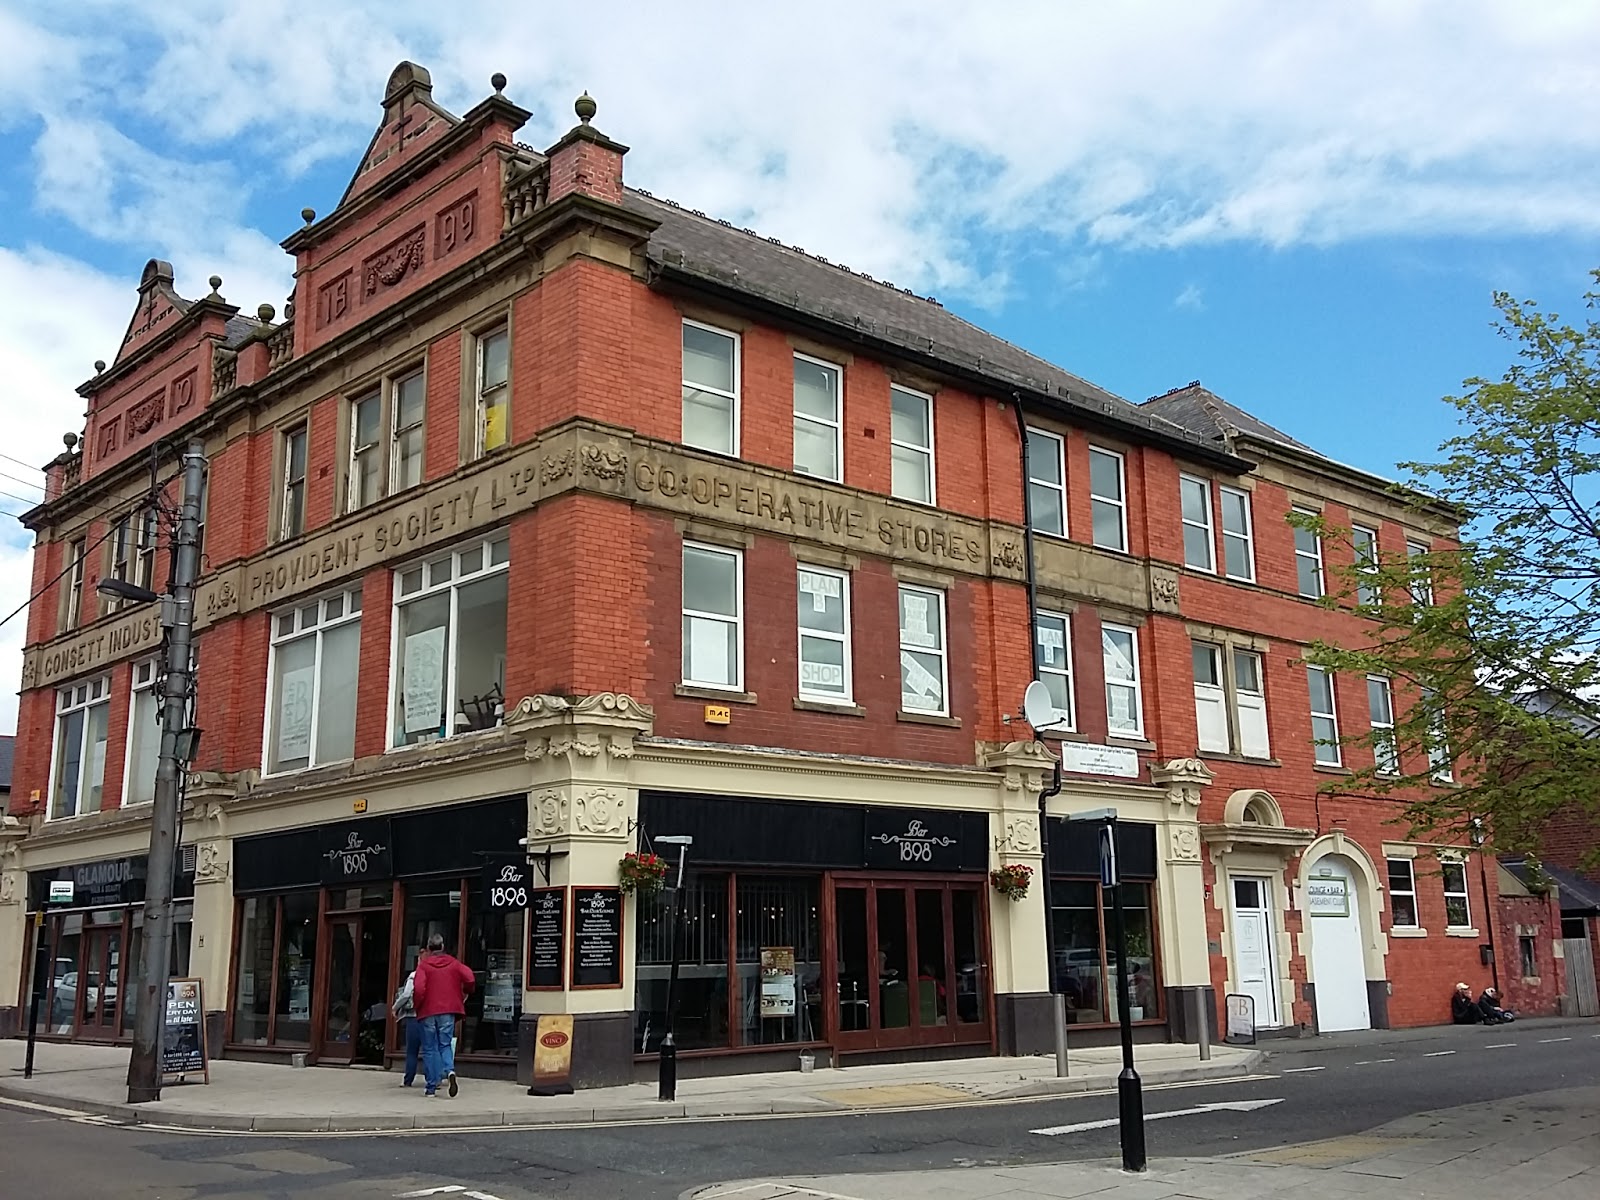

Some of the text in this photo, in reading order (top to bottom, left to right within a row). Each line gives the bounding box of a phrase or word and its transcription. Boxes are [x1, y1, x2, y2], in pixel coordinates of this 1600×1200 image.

[443, 199, 475, 253] 99
[877, 515, 982, 564] STORES
[44, 636, 105, 678] CONSETT
[250, 533, 365, 600] PROVIDENT
[374, 486, 480, 553] SOCIETY
[800, 575, 840, 597] PLAN
[814, 595, 825, 611] B
[1041, 628, 1063, 648] LAN
[802, 664, 841, 683] SHOP
[904, 819, 929, 837] Bar
[346, 831, 364, 850] Bar
[899, 841, 932, 862] 1898
[343, 854, 368, 875] 1898
[496, 864, 524, 883] Bar
[490, 887, 528, 907] 1898
[169, 1001, 195, 1009] PEN
